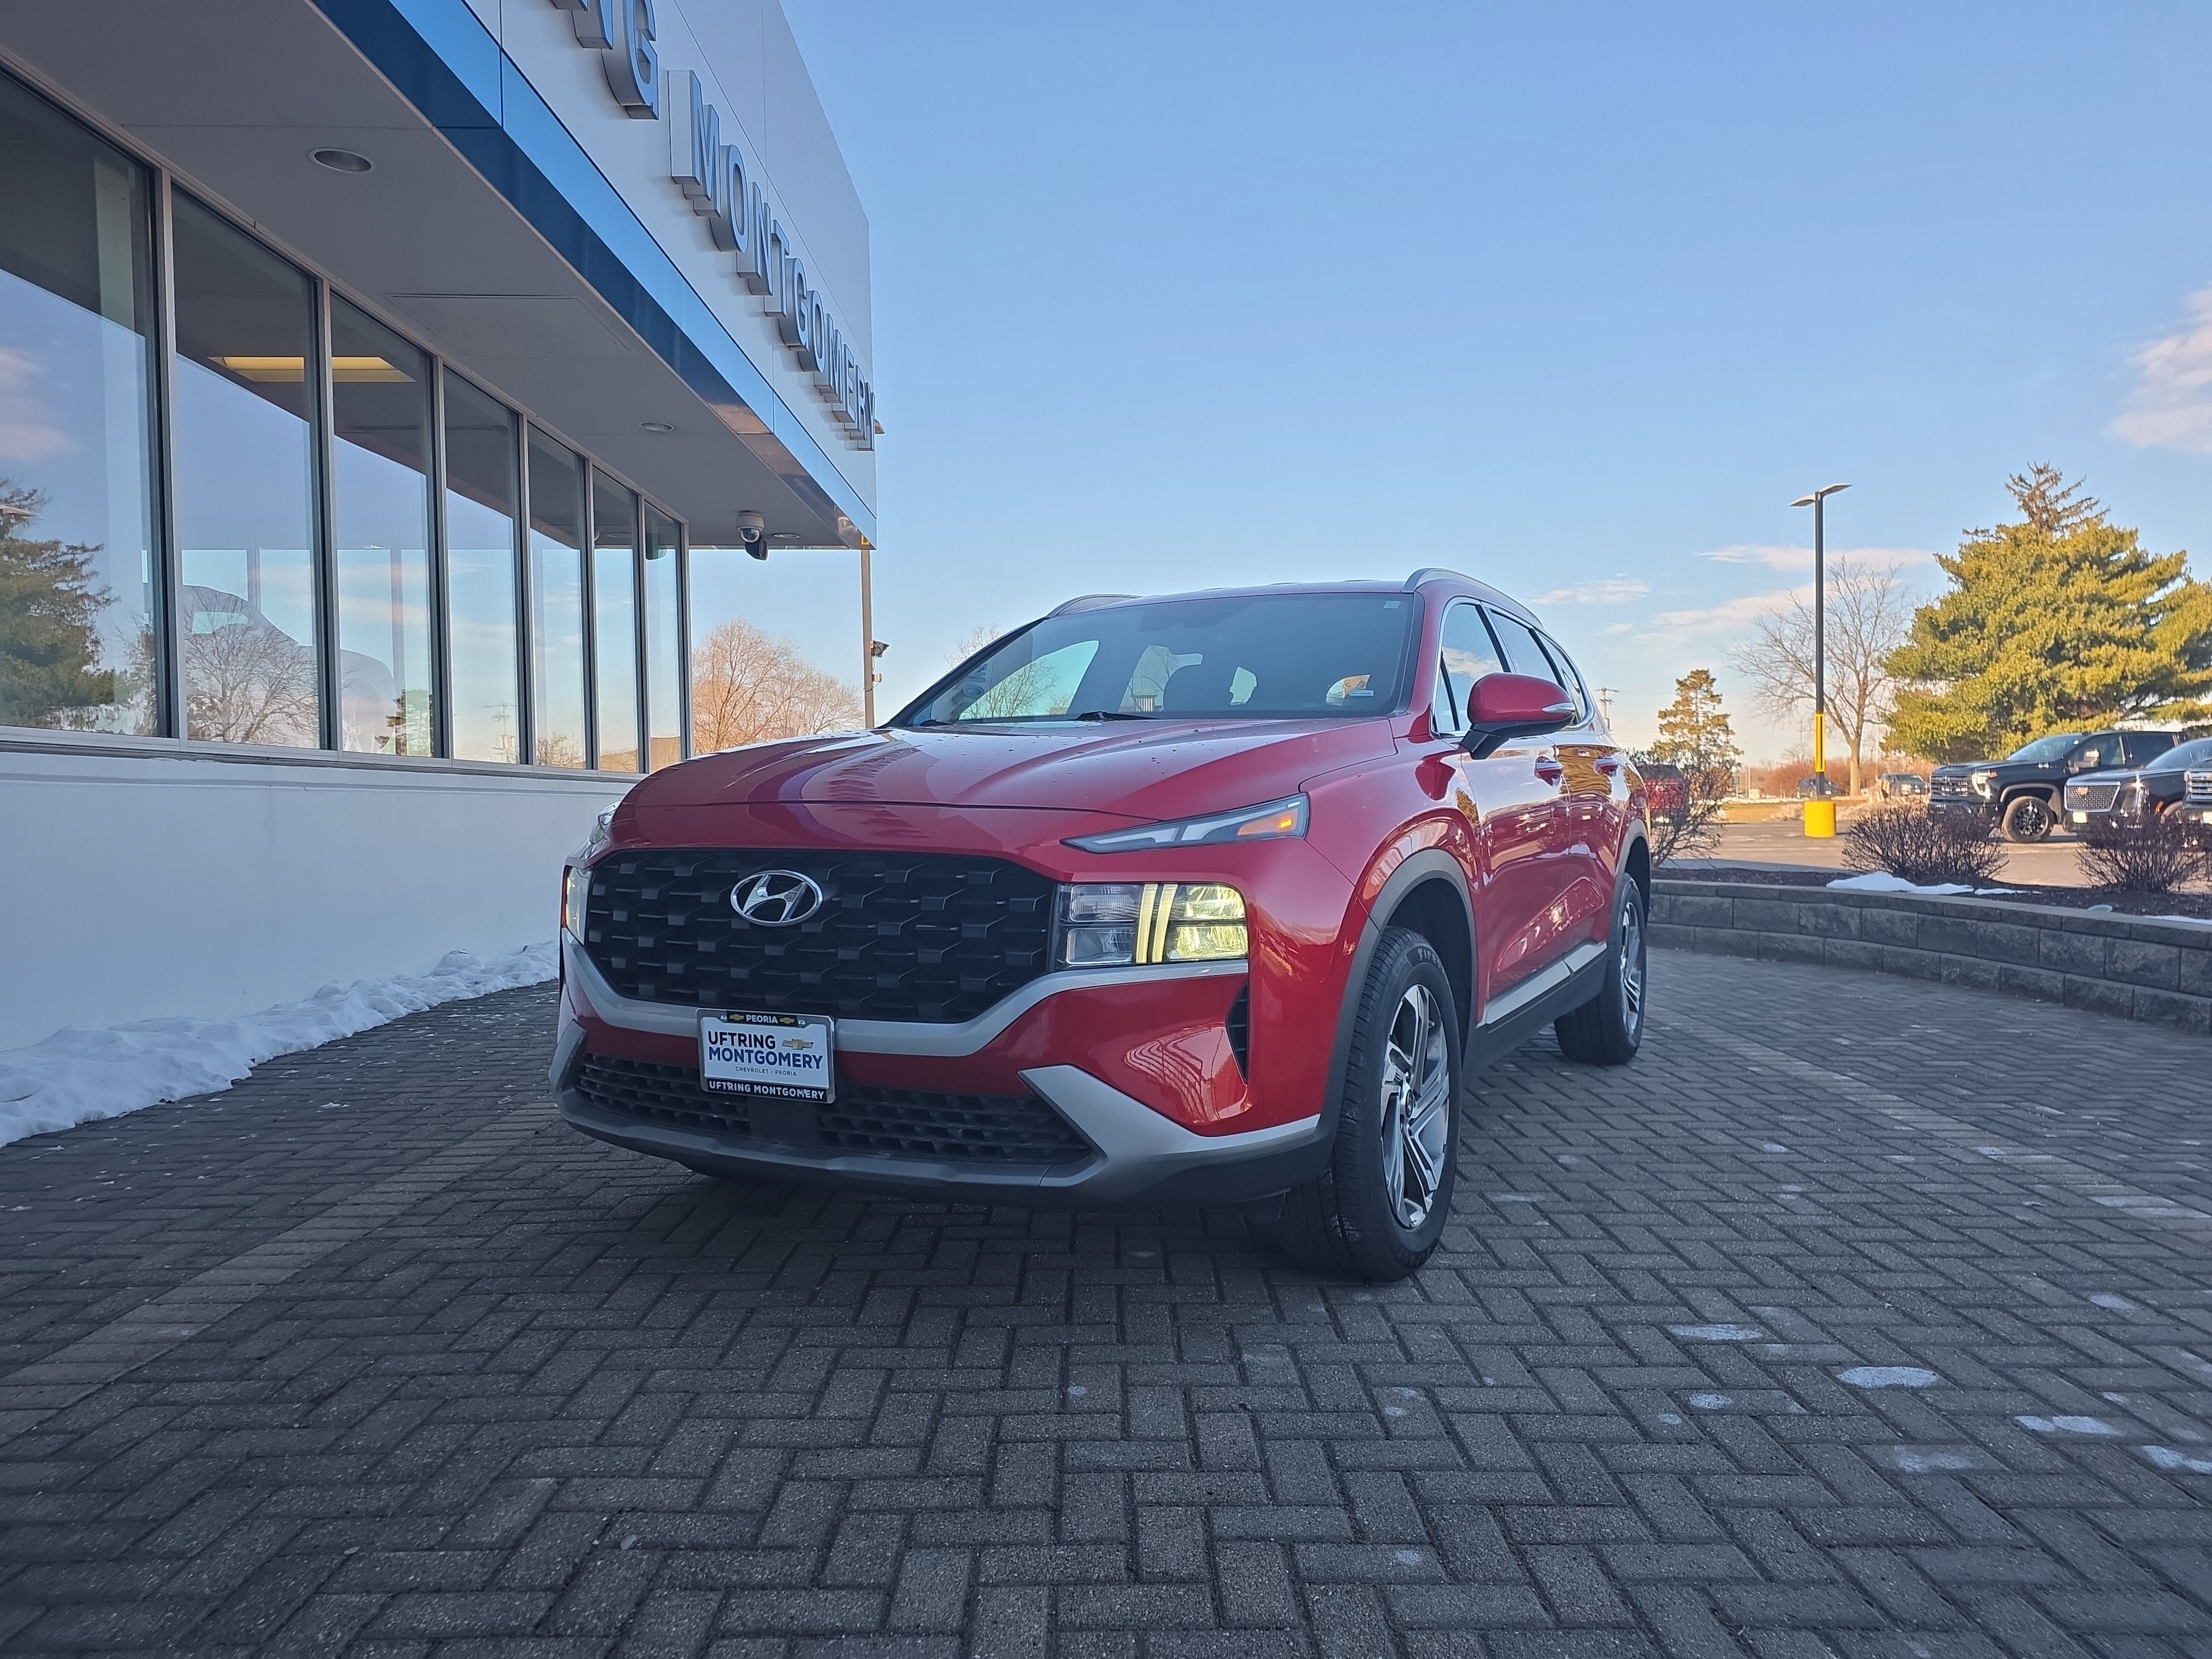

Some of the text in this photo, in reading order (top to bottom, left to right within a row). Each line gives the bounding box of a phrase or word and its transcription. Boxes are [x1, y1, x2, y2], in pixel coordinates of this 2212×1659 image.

[668, 69, 876, 452] MONTGOMERY
[746, 1014, 779, 1024] PEORIA
[708, 1031, 775, 1049] UFTRING
[709, 1047, 823, 1069] MONTGOMERY
[709, 1081, 824, 1099] UFTRING MONTGOMERY
